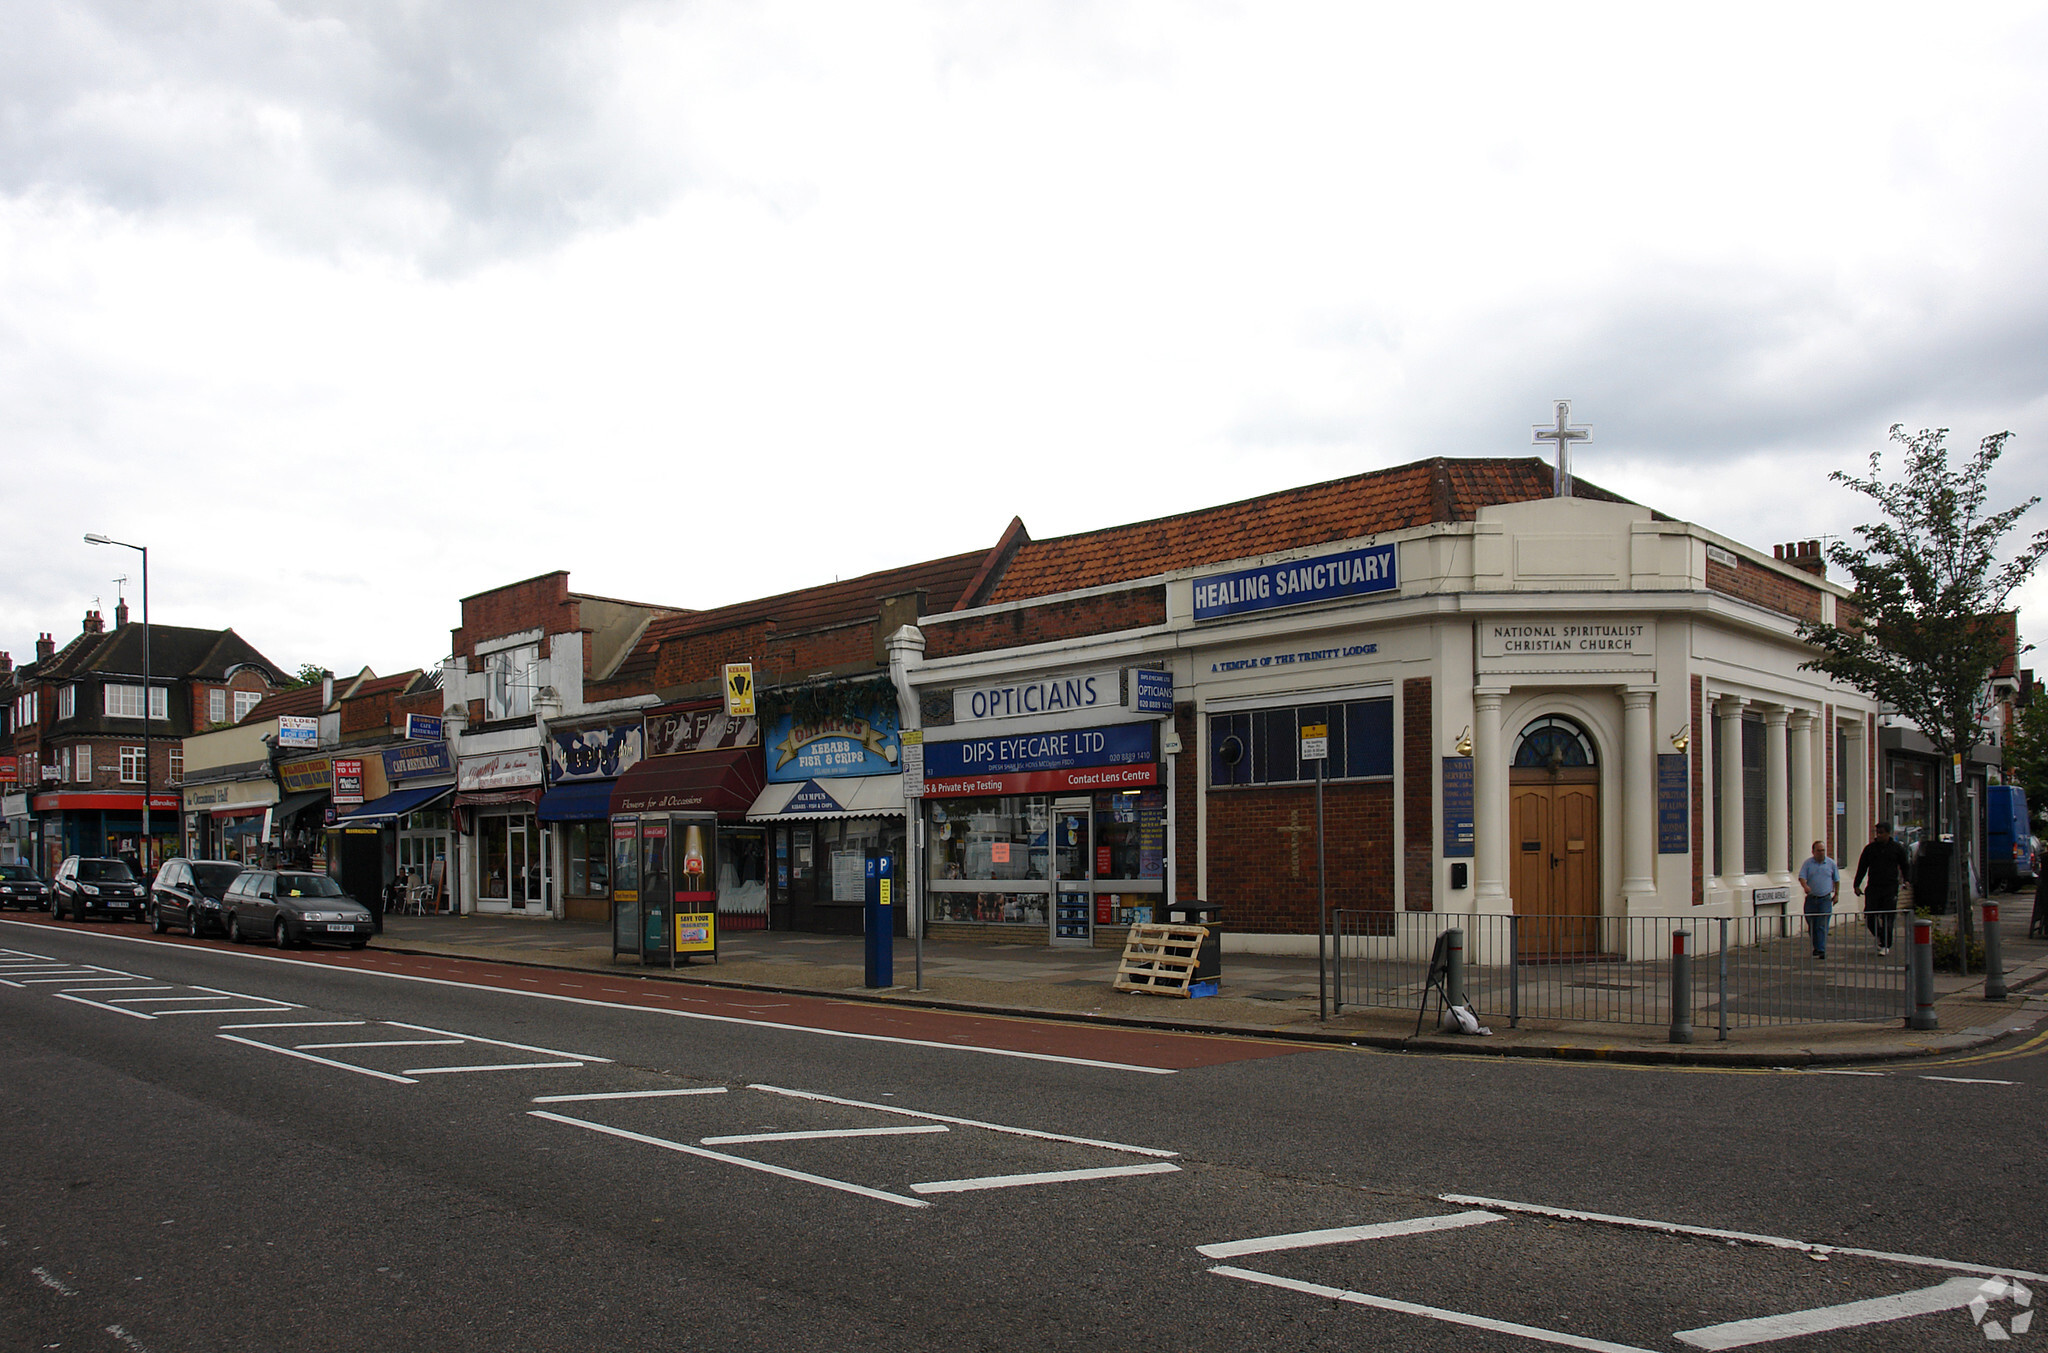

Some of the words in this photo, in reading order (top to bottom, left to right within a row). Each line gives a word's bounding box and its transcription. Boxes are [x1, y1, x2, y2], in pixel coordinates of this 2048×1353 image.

[1195, 574, 1270, 610] HEALING
[1276, 552, 1392, 596] SANCTUARY
[1494, 626, 1557, 638] NATIONAL
[1563, 625, 1644, 637] SPIRITUALIST
[1504, 639, 1572, 651] CHRISTIAN
[1579, 639, 1633, 650] CHURCH
[1211, 663, 1218, 673] A
[1219, 658, 1258, 672] TEMPLE
[1259, 656, 1272, 667] OF
[1274, 653, 1295, 666] THE
[1297, 648, 1342, 663] TRINITY
[1342, 643, 1378, 657] LODGE
[971, 676, 1097, 718] OPTICIANS
[1138, 684, 1173, 699] OPTICIANS
[794, 718, 863, 743] OLYMPUS
[810, 741, 851, 756] KEBABS
[963, 741, 995, 764] DIPS
[1000, 735, 1069, 761] EYECARE
[1075, 732, 1105, 754] LTD
[798, 755, 823, 768] FISH
[825, 754, 833, 766] &
[834, 751, 864, 765] CHIPS
[1109, 754, 1120, 762] 020
[1122, 753, 1136, 761] 8889
[1137, 751, 1151, 760] 1410
[1067, 772, 1100, 785] Contact
[1101, 772, 1118, 783] Lens
[1118, 770, 1150, 782] Centre
[931, 782, 937, 793] &
[937, 780, 962, 793] Private
[963, 779, 976, 792] Eye
[977, 779, 1003, 793] Testing
[622, 799, 646, 809] Flowers
[646, 796, 657, 811] for
[658, 795, 668, 808] all
[797, 792, 827, 801] OLYMPUS
[868, 861, 874, 873] P
[880, 858, 888, 872] P
